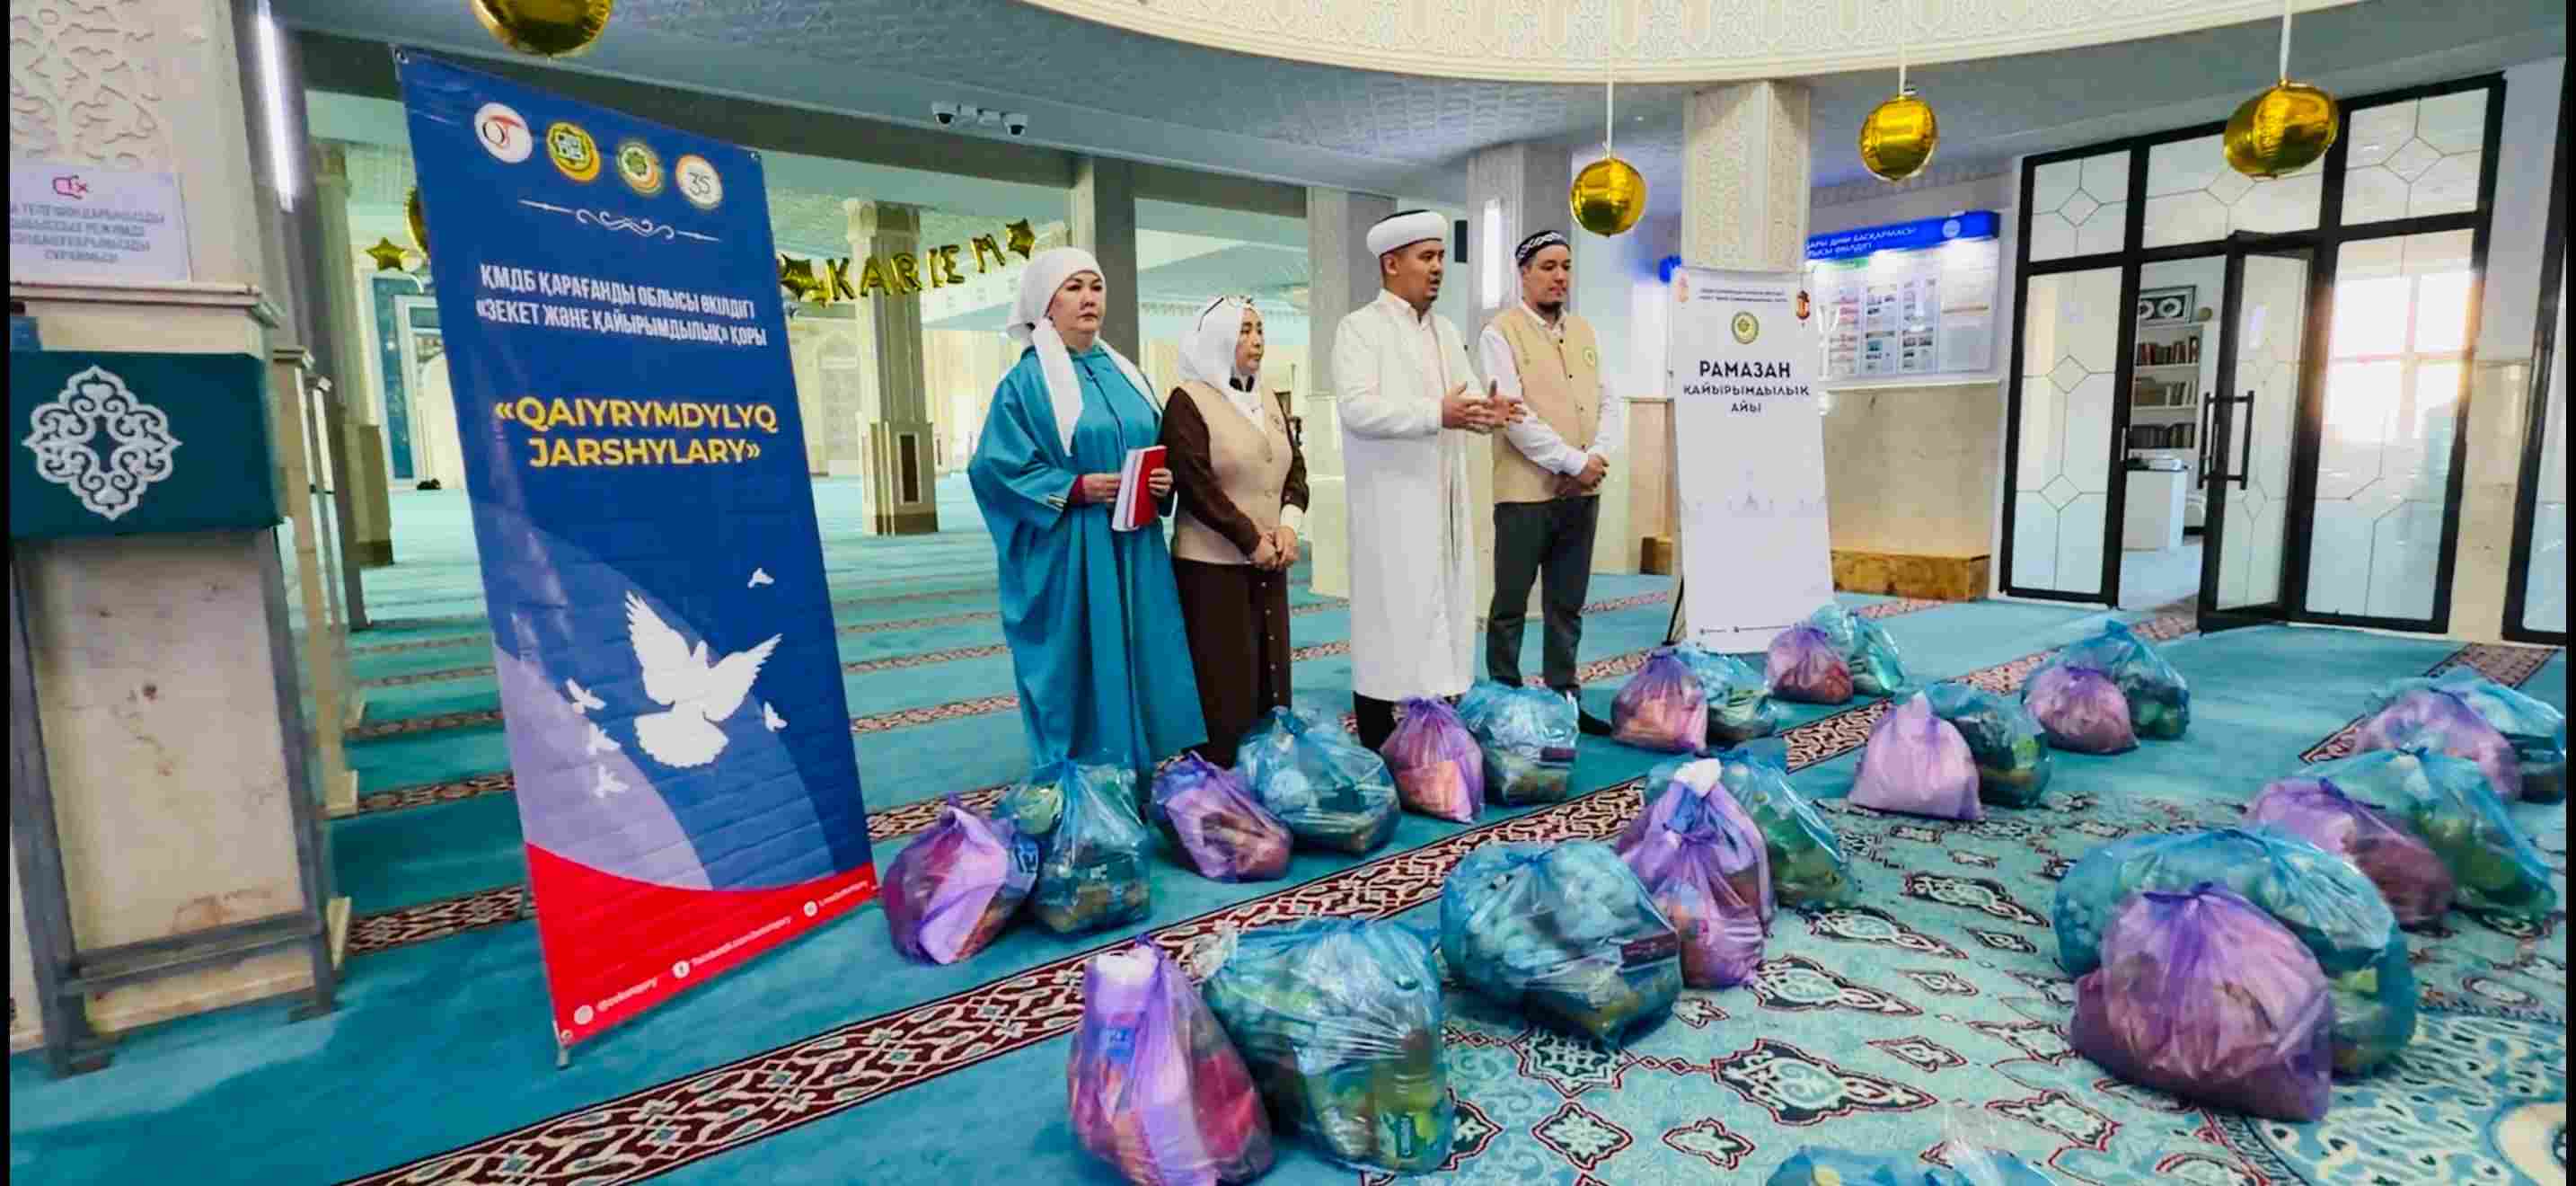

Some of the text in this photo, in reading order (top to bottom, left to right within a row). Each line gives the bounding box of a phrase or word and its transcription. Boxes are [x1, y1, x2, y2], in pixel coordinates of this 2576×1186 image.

[480, 263, 536, 293] ҚМДБ
[539, 270, 636, 305] ҚАРАҒАНДЫ
[637, 286, 700, 313] ОБЛЫСЫ
[475, 298, 539, 325] «ЗЕКЕТ
[543, 305, 591, 330] ЖӘНЕ
[730, 326, 768, 347] ҚОРЫ
[1699, 360, 1791, 378] РАМАЗАН
[495, 396, 779, 433] «QAIYRYMDYLYQ
[1731, 400, 1761, 413] АЙЫ
[528, 438, 762, 467] JARSHYLARY»
